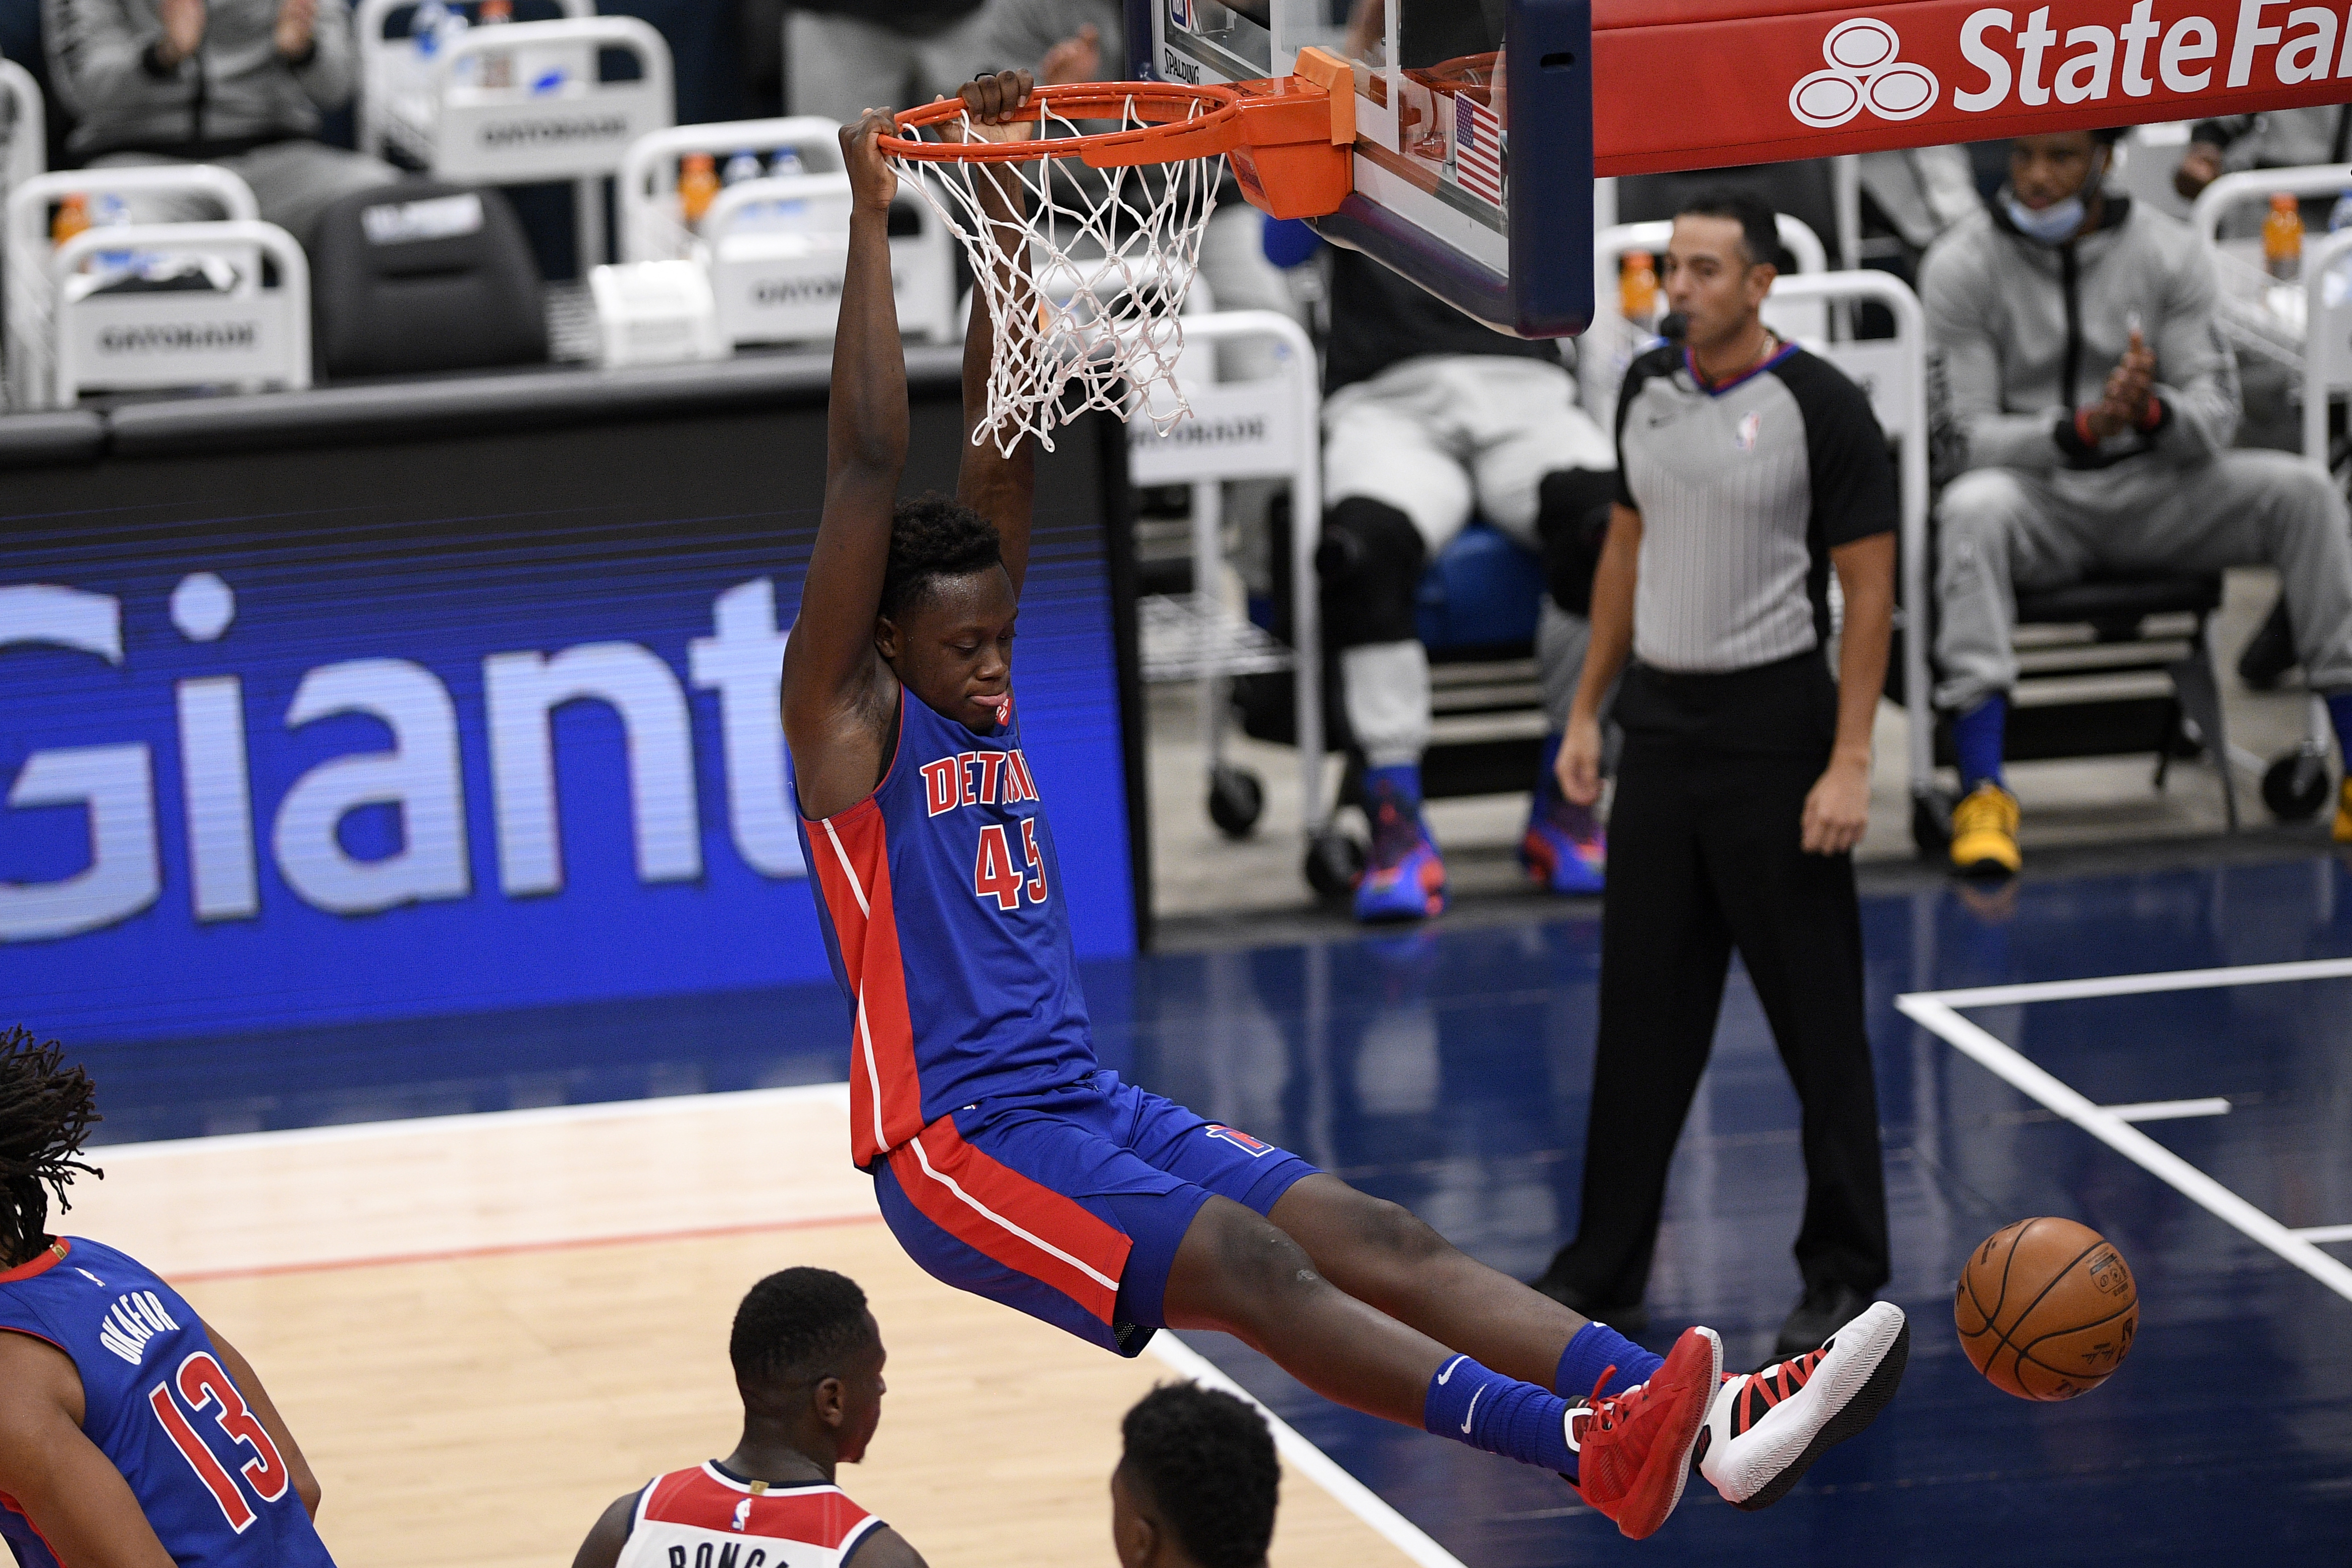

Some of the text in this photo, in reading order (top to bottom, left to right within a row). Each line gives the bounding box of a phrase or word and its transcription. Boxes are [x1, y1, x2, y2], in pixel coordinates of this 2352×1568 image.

[1165, 48, 1199, 85] SPALDING
[2226, 0, 2352, 88] Fa
[0, 571, 808, 942] Giant
[975, 817, 1048, 911] 45
[100, 1291, 180, 1365] OKAFOR
[148, 1351, 289, 1534] 13
[668, 1542, 790, 1568] BON
